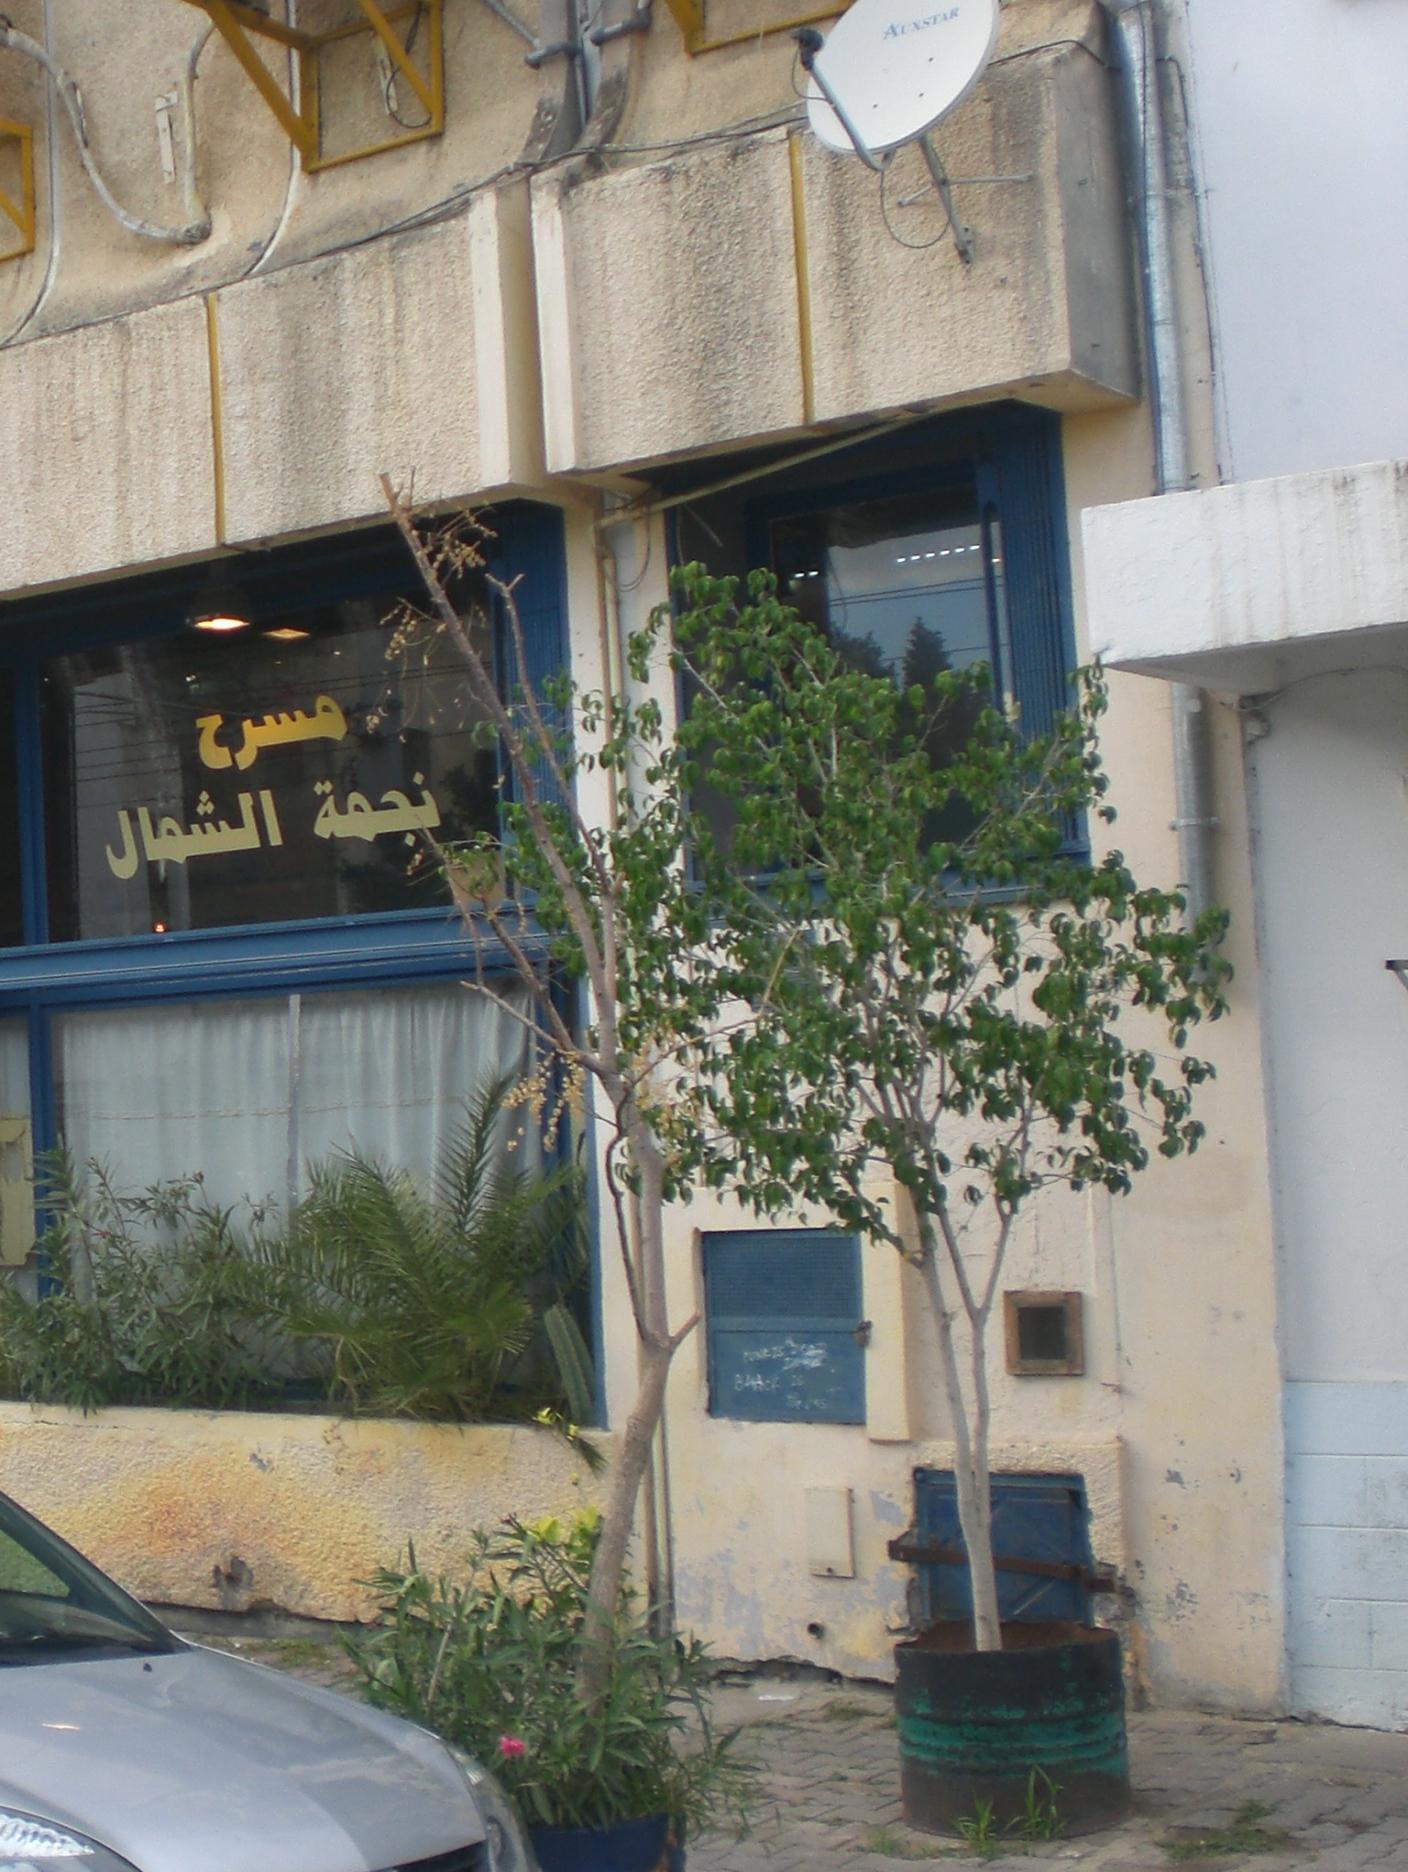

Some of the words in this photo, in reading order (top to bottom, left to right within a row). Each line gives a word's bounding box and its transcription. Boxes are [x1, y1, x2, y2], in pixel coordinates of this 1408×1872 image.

[195, 695, 348, 770] مسرح
[106, 789, 283, 879] الشمال
[313, 771, 441, 847] نجمة
